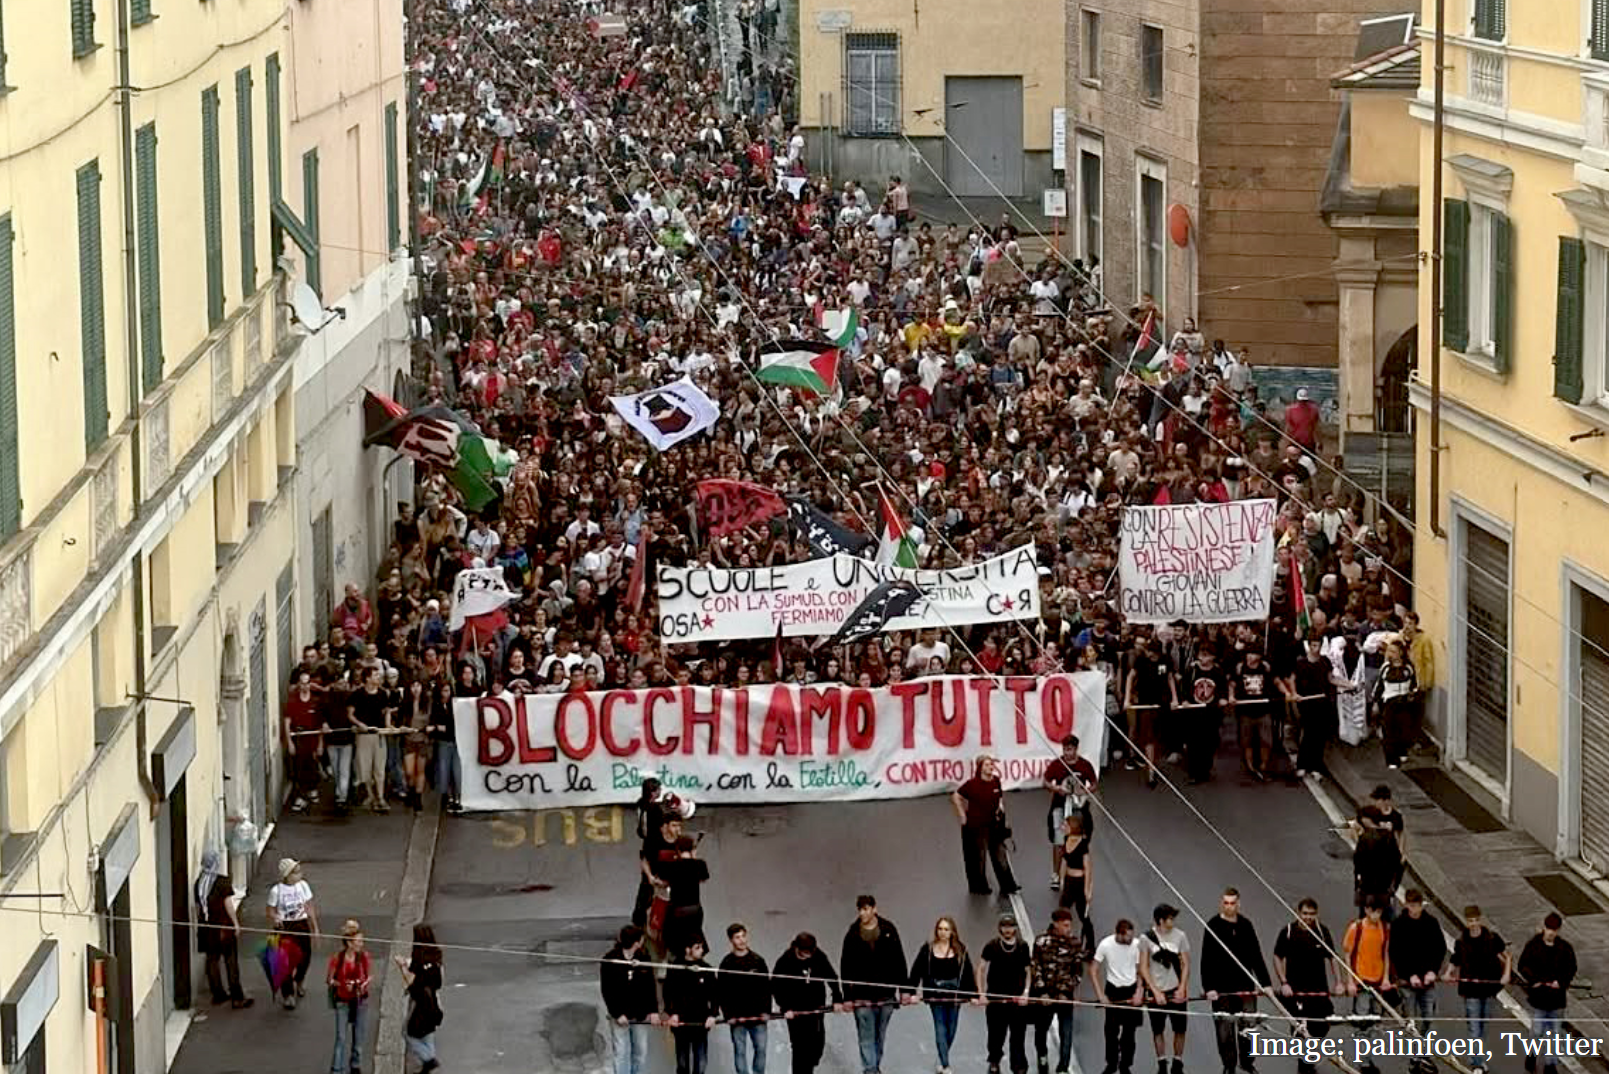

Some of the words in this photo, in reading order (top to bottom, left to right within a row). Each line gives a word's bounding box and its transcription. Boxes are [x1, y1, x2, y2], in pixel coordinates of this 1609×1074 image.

[1122, 508, 1156, 533] CON
[659, 568, 788, 600] SCUOLE
[1156, 570, 1222, 592] GIOVANI
[701, 594, 740, 613] CON
[746, 594, 769, 611] LA
[828, 589, 857, 606] CON
[1122, 588, 1176, 615] CONTRO
[1183, 587, 1204, 616] LA
[1206, 585, 1265, 614] GUERRA
[660, 612, 702, 638] OSA
[771, 607, 844, 625] FERMIAMO
[477, 683, 875, 766] BLOCCHIAMO
[890, 676, 1074, 749] TUTTO
[563, 763, 597, 793] la
[717, 771, 756, 790] con
[766, 762, 793, 788] la
[886, 759, 964, 784] CONTRO
